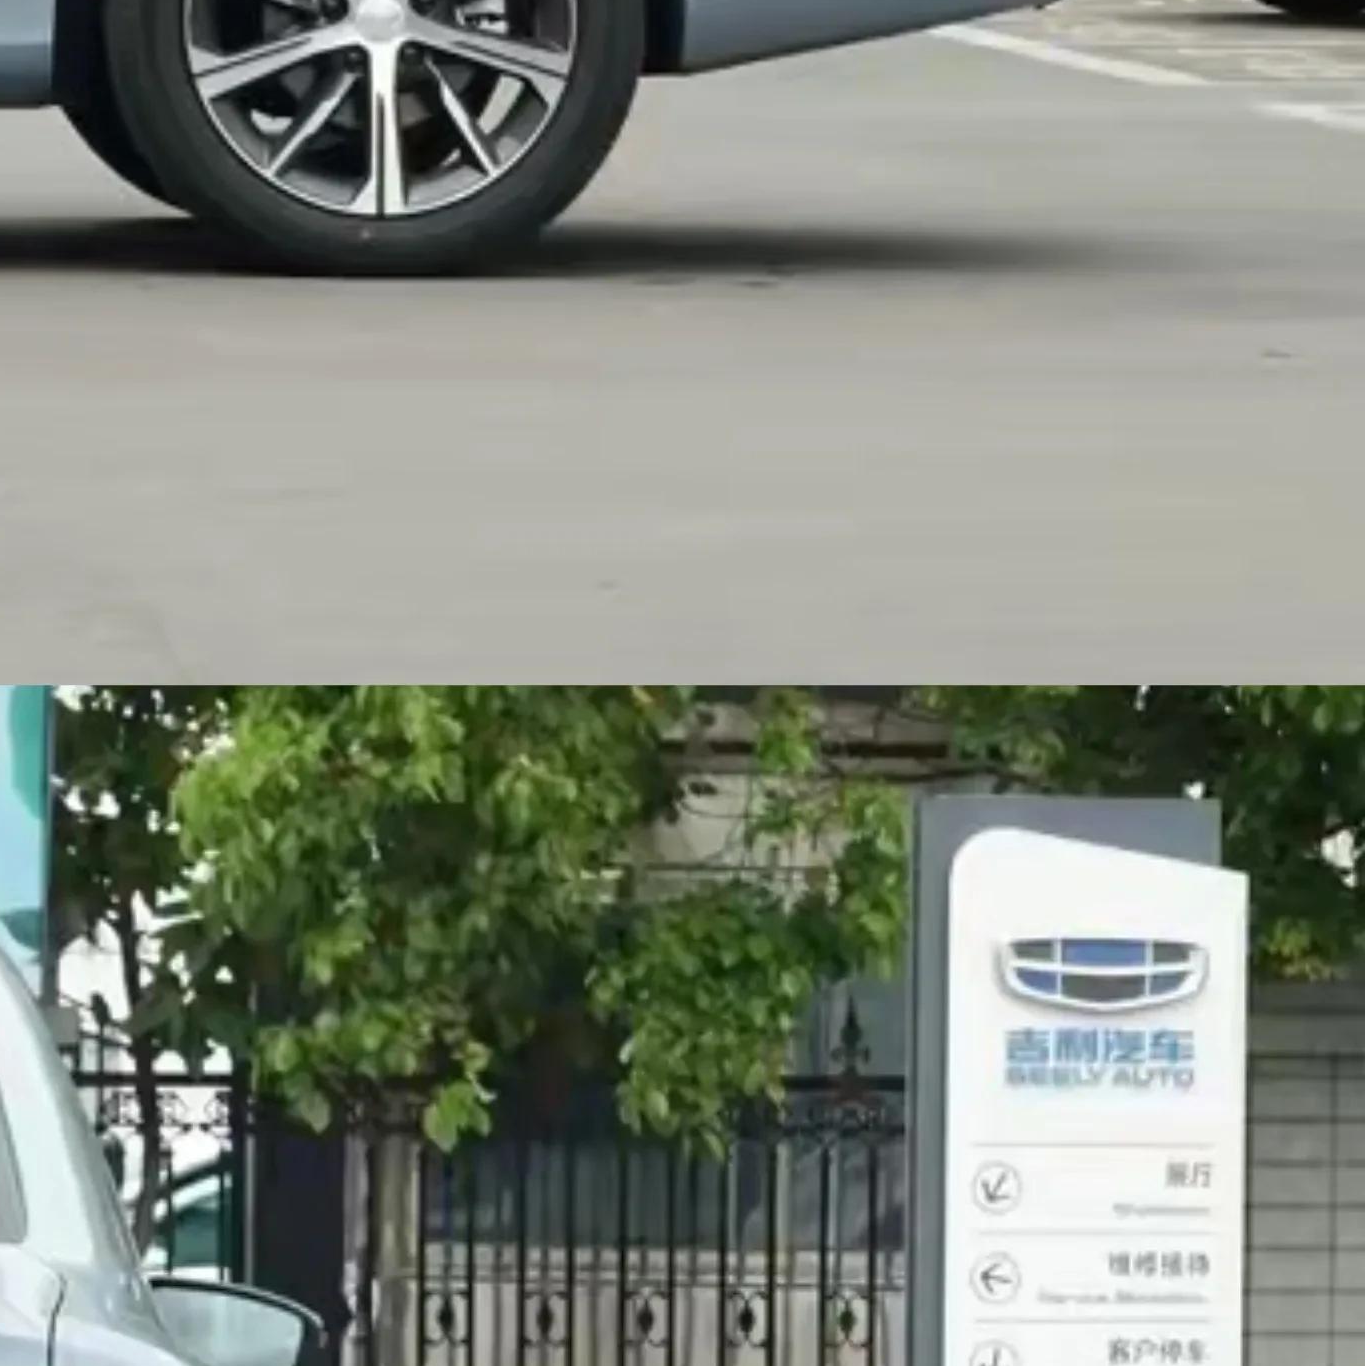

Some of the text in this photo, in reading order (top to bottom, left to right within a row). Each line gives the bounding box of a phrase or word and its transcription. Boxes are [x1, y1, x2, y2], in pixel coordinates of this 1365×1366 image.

[1006, 1029, 1195, 1063] 吉利汽车
[1110, 1067, 1195, 1088] AUTO
